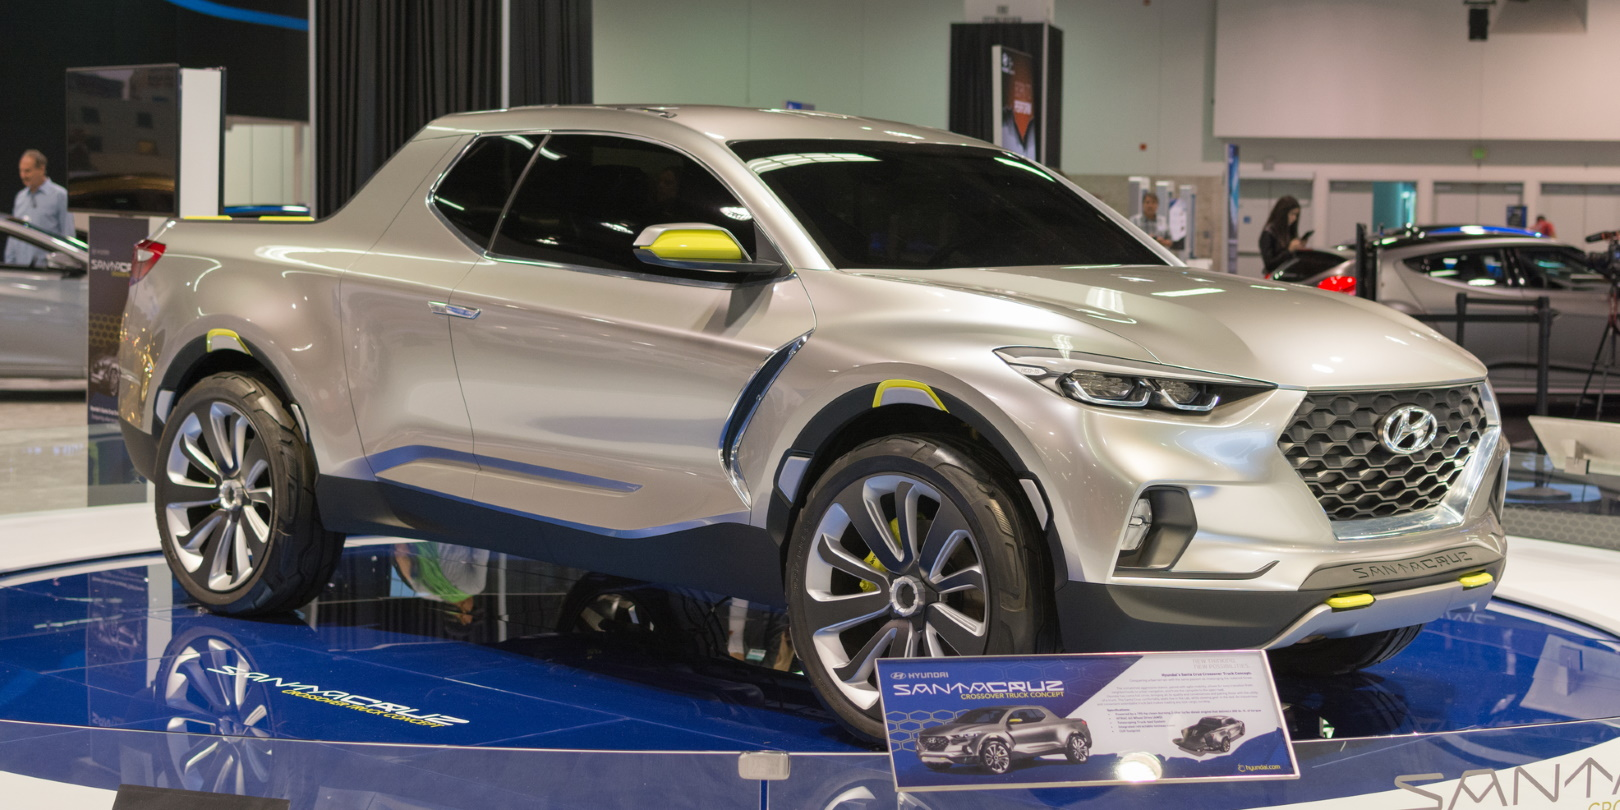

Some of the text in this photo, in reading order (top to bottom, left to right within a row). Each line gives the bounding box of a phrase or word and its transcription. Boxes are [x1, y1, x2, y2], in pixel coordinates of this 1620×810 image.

[1353, 552, 1473, 579] SANTACRUZ
[206, 665, 470, 726] SANTACRUZ
[893, 680, 1064, 696] SANTACRUZ
[960, 692, 1004, 700] CROSSOVER
[281, 689, 446, 728] CROSSOVER TRUCK CONCEPT
